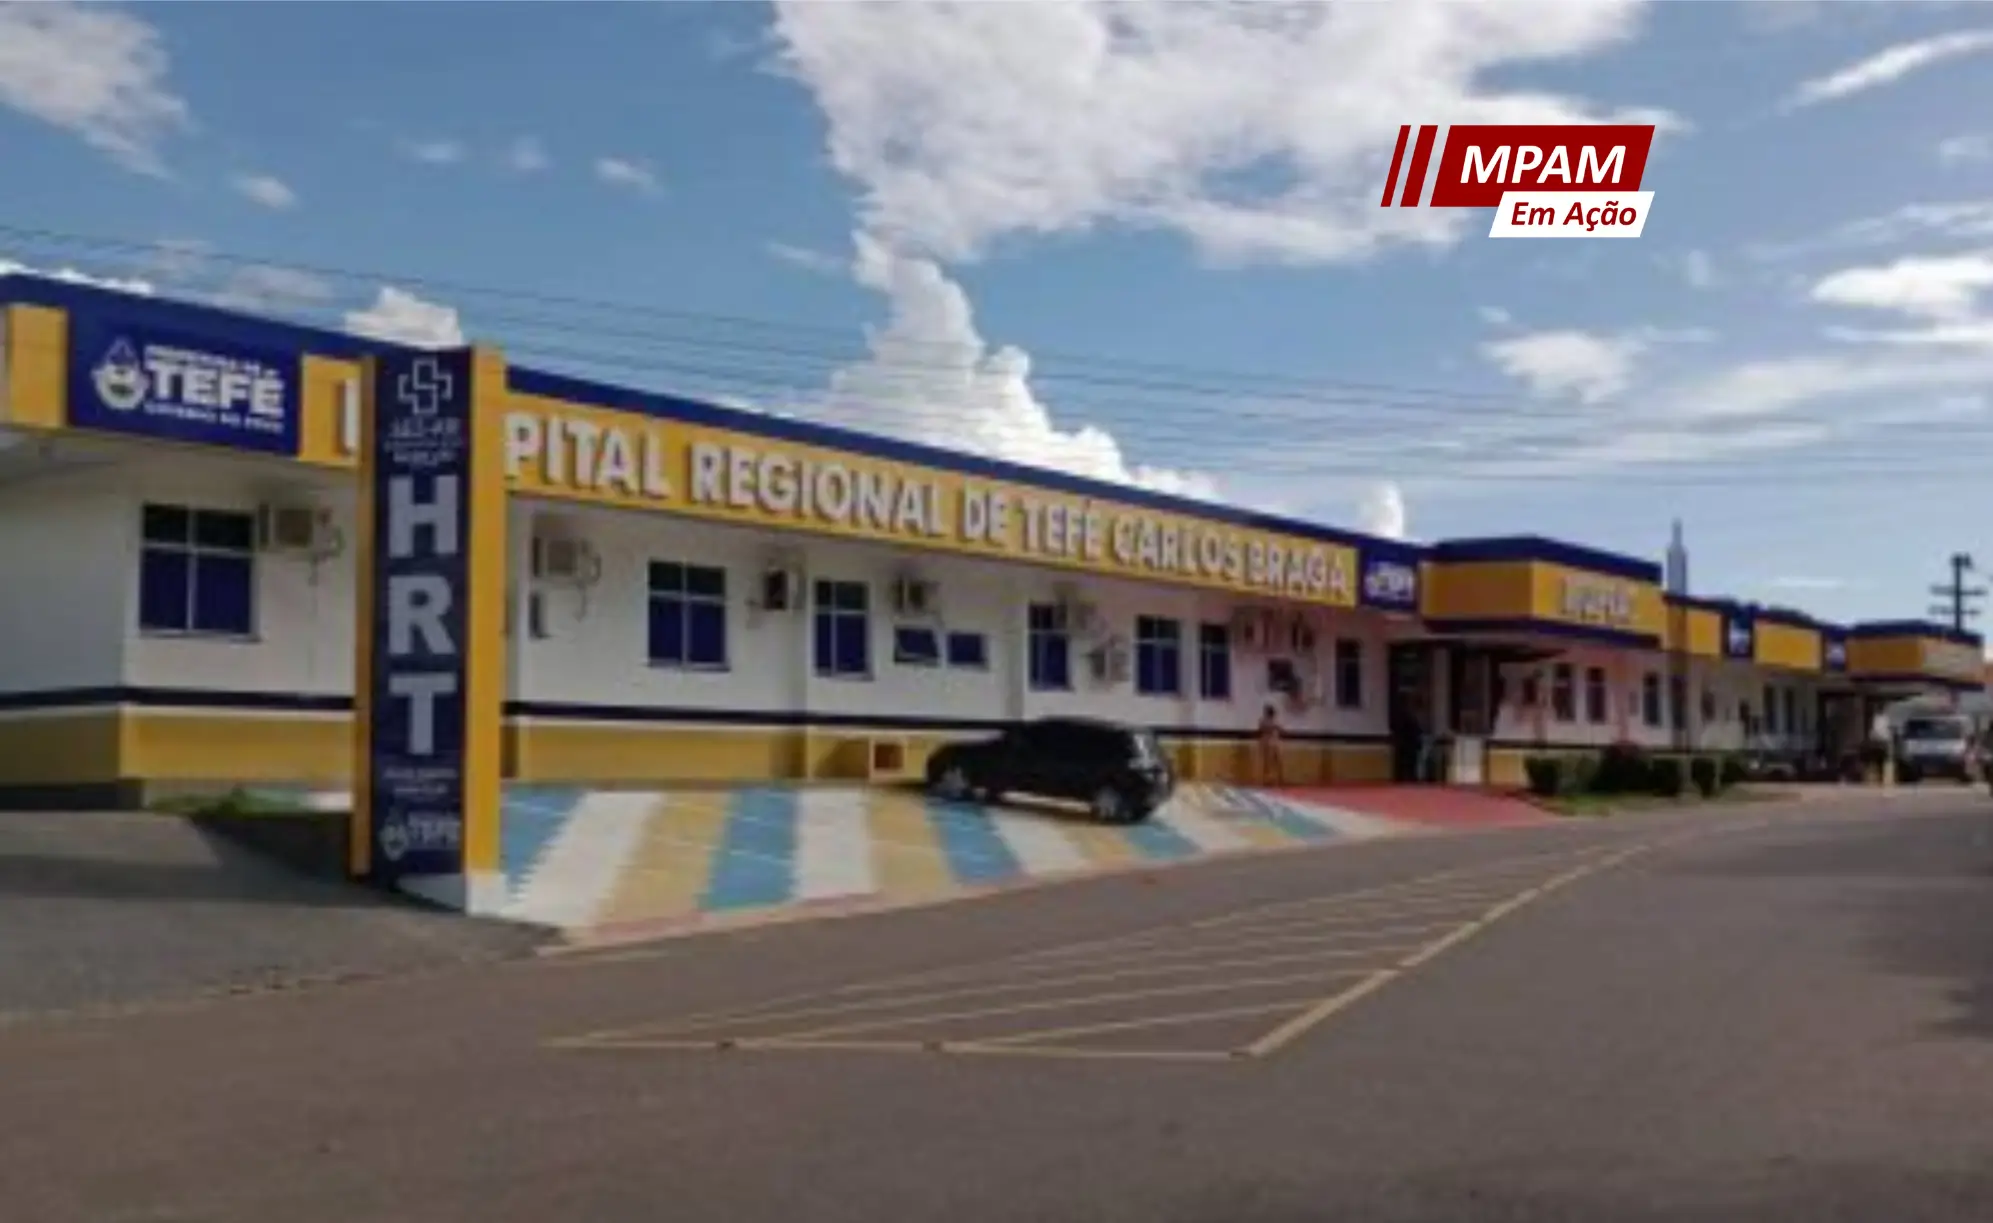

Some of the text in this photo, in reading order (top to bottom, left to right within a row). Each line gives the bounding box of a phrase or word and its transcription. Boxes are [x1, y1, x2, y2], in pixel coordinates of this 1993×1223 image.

[146, 361, 286, 418] TEFÉ
[690, 443, 945, 536] REGIONAL
[962, 481, 1006, 541] DE
[1115, 513, 1243, 582] CARLOS
[1249, 541, 1350, 600] BRAGA
